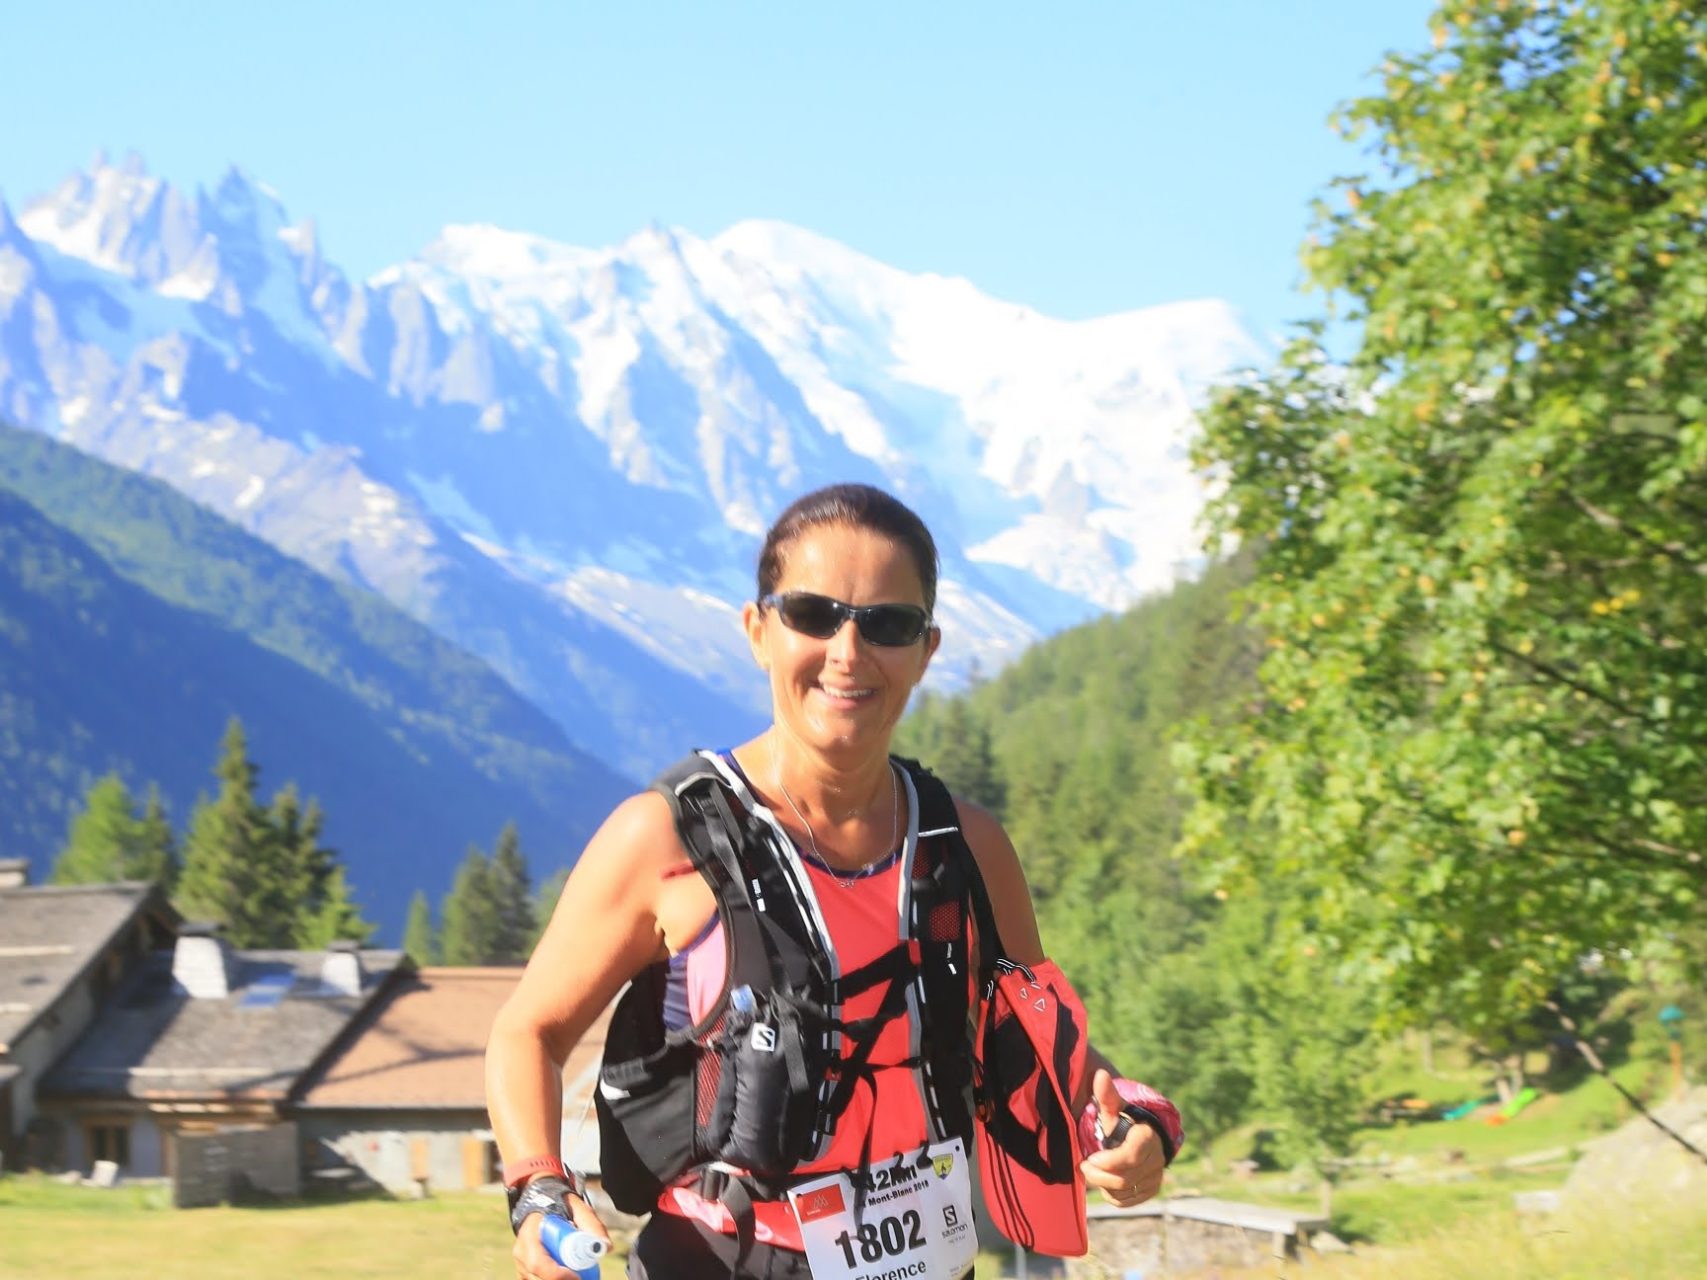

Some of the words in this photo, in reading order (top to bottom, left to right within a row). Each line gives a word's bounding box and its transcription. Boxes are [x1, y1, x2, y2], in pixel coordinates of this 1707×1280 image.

[868, 1187, 913, 1207] Mont-Blanc
[914, 1180, 929, 1192] 2018
[835, 1209, 927, 1270] 1802
[942, 1223, 968, 1239] salomon
